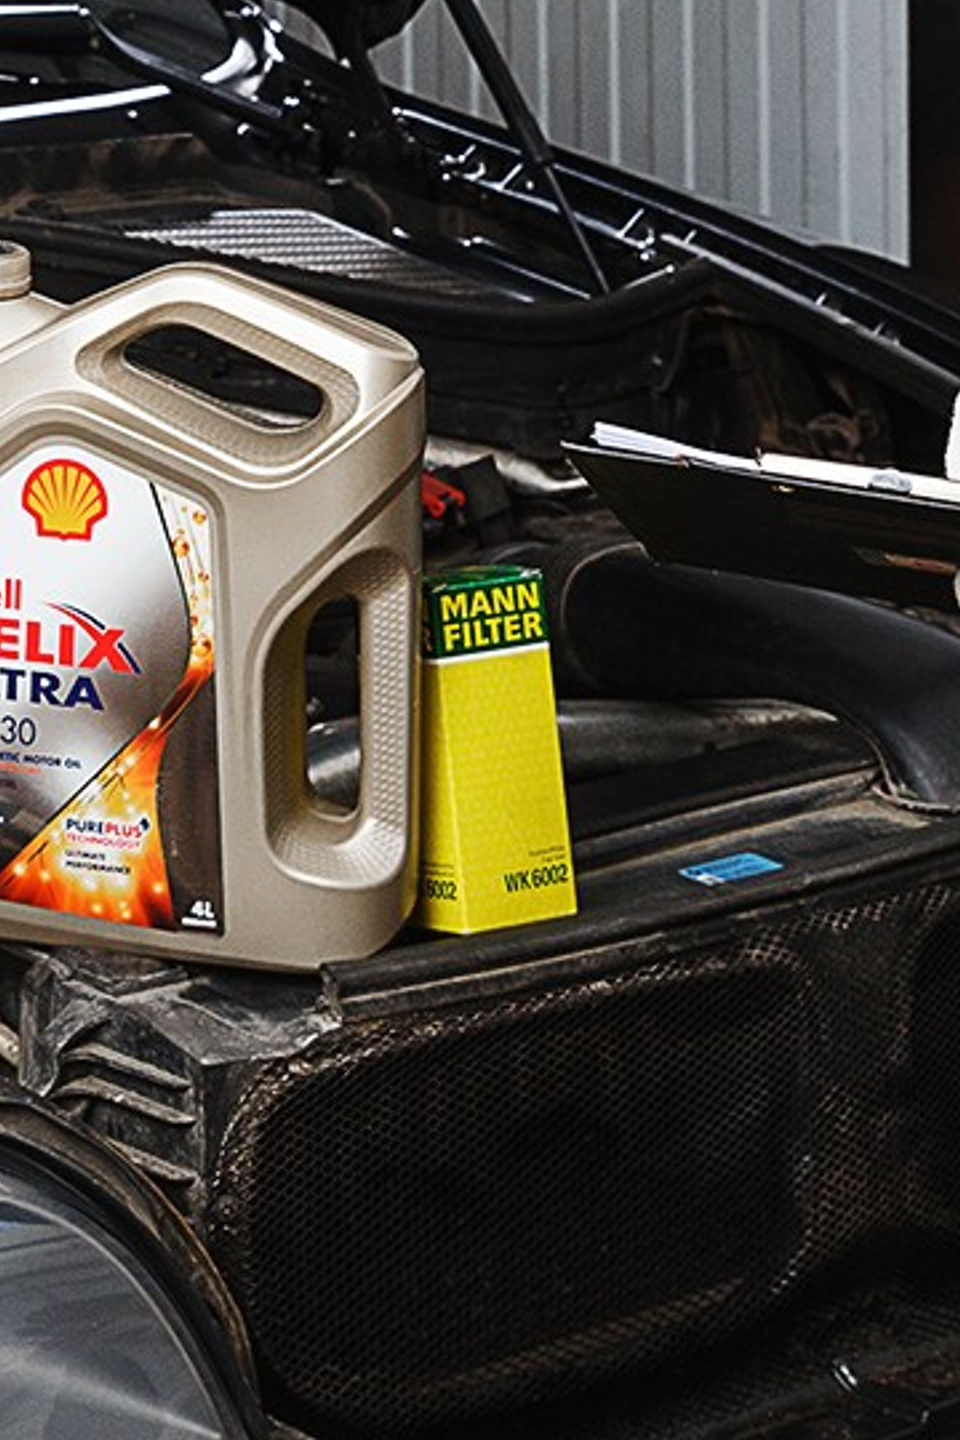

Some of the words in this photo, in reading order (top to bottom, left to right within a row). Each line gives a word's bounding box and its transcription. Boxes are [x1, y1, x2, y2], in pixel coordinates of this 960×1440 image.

[440, 581, 540, 622] MANN
[443, 611, 543, 652] FILTER
[23, 754, 61, 767] MOTOR
[64, 757, 82, 769] OIL
[66, 818, 142, 838] PUREPLUS
[65, 833, 140, 849] TECHNOLOGY
[503, 870, 531, 893] WK
[531, 863, 568, 889] 6002
[191, 900, 215, 919] 4L
